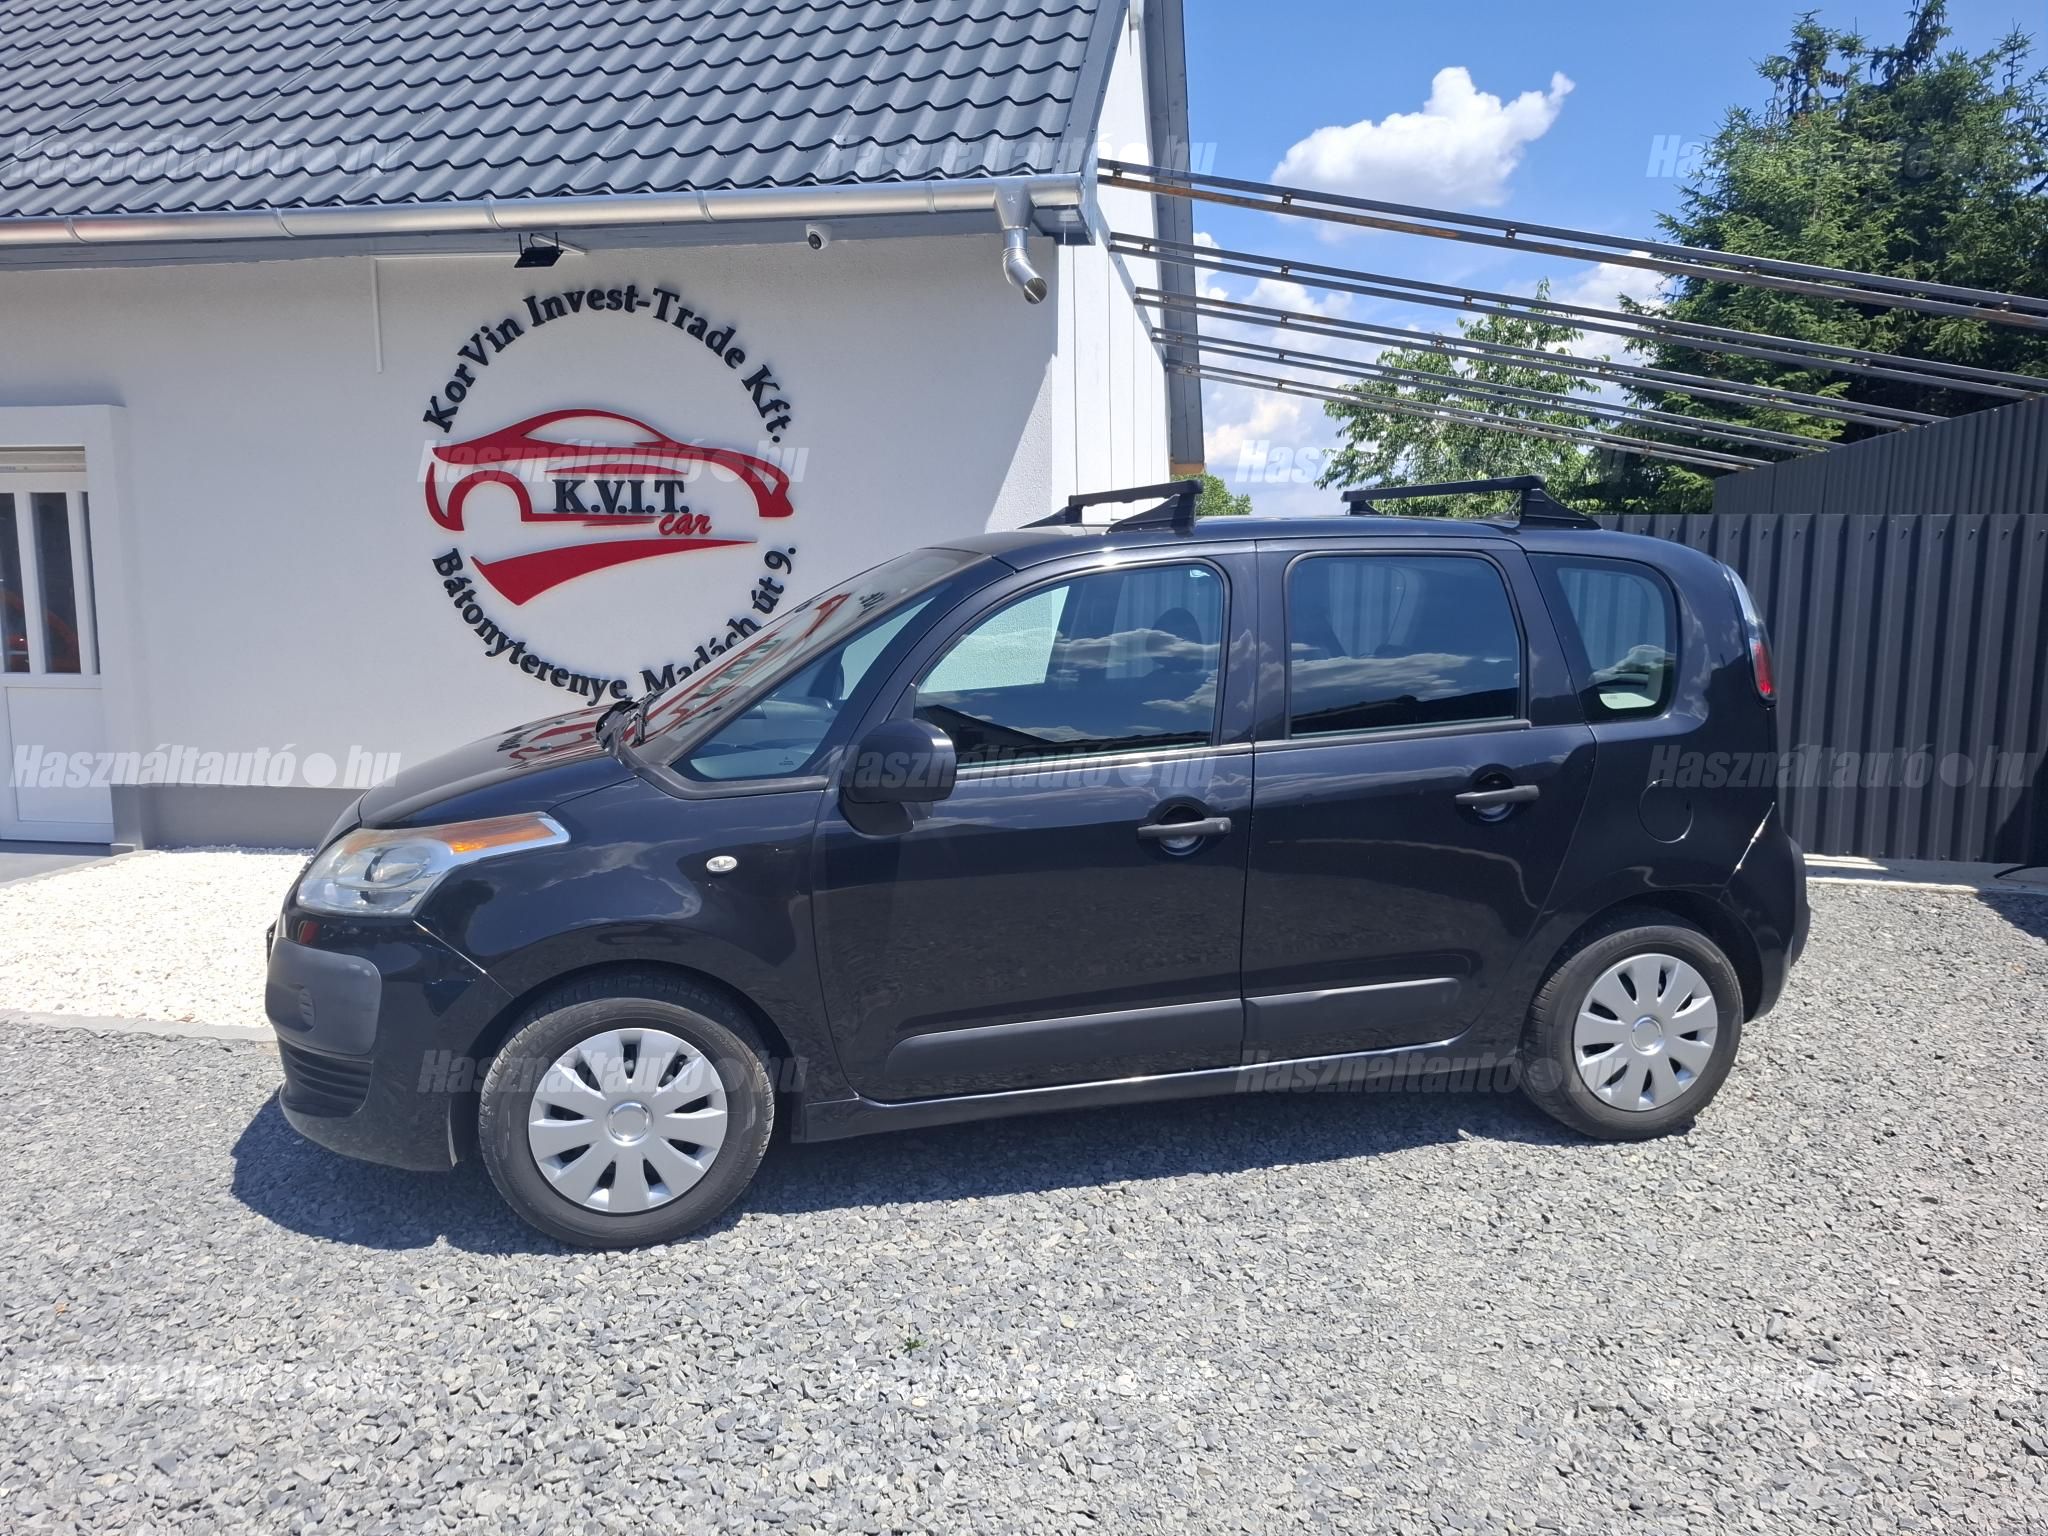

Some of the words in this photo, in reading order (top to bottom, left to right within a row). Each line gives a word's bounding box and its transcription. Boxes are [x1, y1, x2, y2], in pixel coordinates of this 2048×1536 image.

[422, 317, 525, 434] KorVin
[522, 283, 747, 371] Invest-Trade
[740, 363, 792, 444] Kft.
[551, 478, 690, 515] K.V.I.T.
[658, 512, 713, 537] car
[763, 546, 798, 575] 9.
[750, 575, 786, 615] út
[638, 618, 763, 694] Madách
